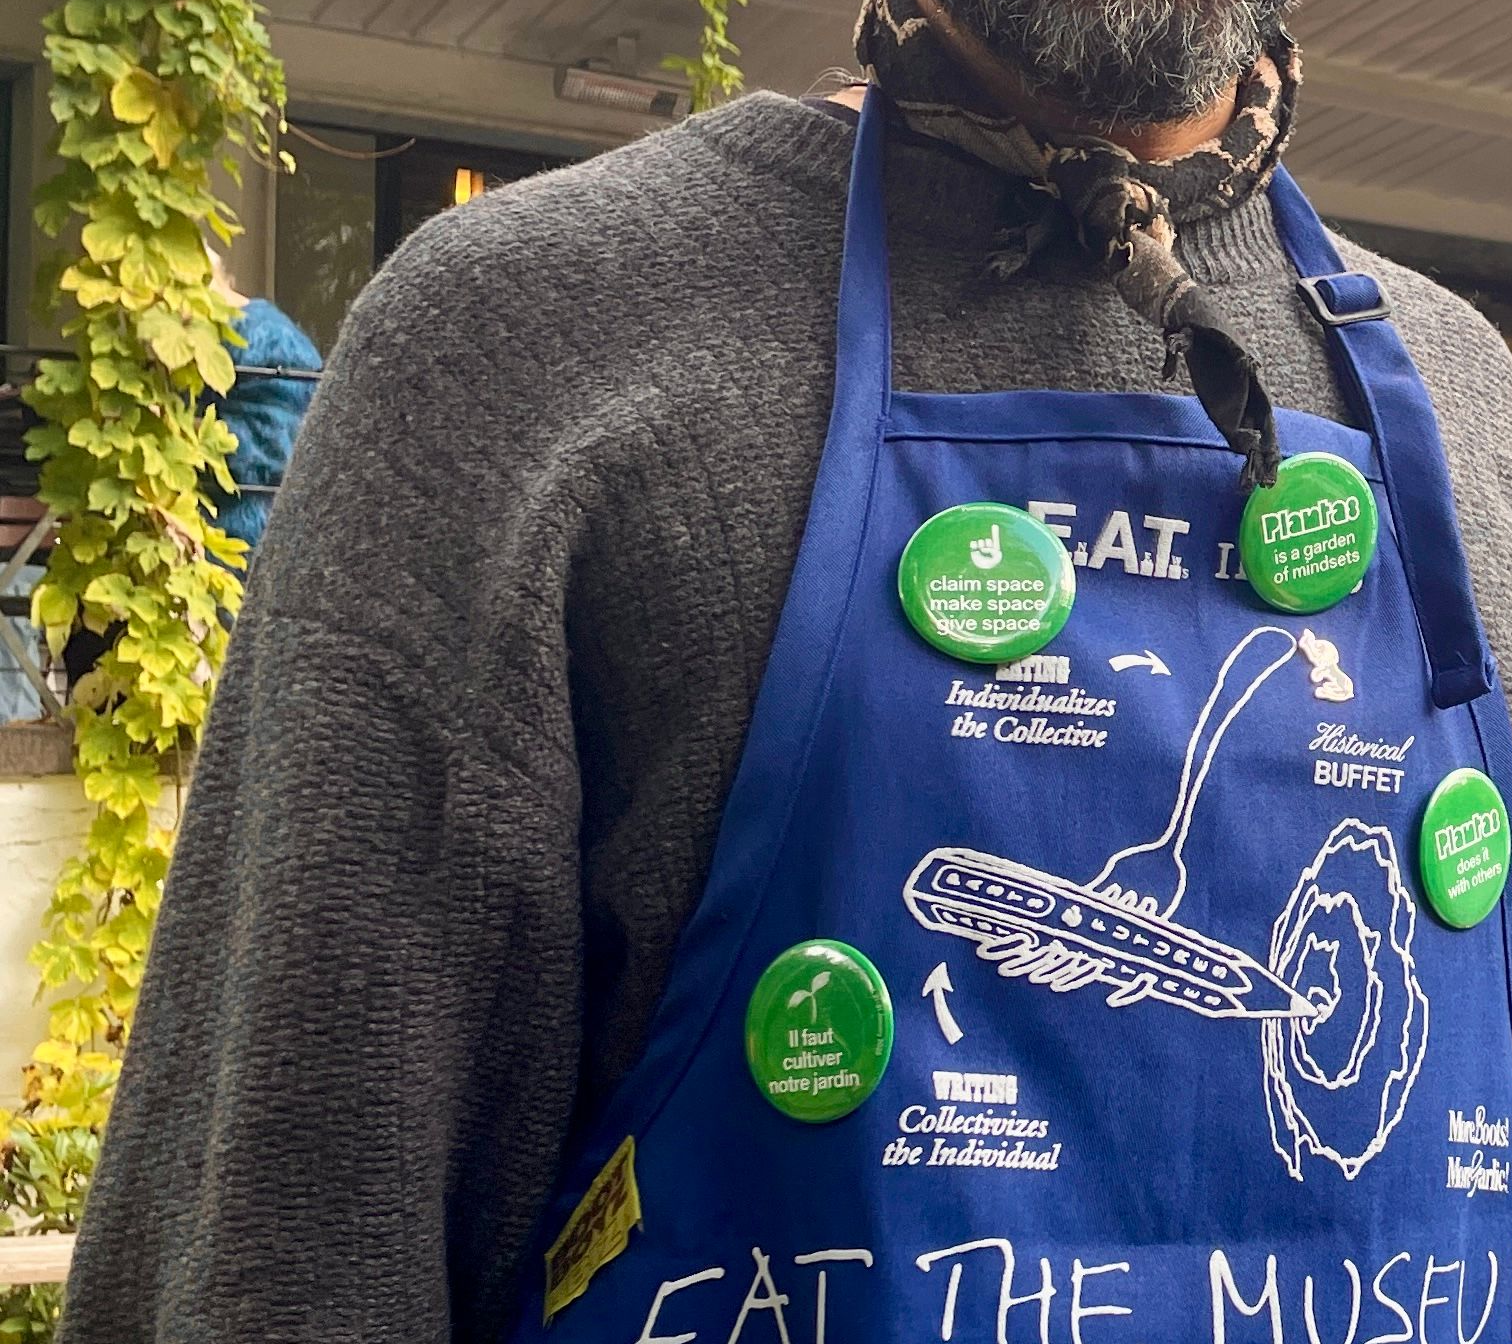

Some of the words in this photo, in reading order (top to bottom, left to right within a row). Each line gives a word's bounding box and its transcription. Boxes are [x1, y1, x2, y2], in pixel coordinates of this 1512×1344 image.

[1261, 496, 1360, 544] Plantas
[1274, 549, 1287, 565] is
[1290, 549, 1300, 561] a
[1303, 532, 1356, 563] garden
[1273, 567, 1289, 584] of
[1292, 550, 1361, 579] mindsets
[930, 575, 982, 592] claim
[986, 578, 1044, 595] space
[930, 595, 983, 612] make
[987, 599, 1047, 615] space
[937, 617, 977, 635] give
[982, 618, 1041, 634] space
[945, 680, 1117, 718] Individualizes
[951, 711, 988, 739] the
[993, 716, 1108, 748] Collective
[1308, 722, 1415, 762] Historical
[1313, 760, 1405, 793] BUFFET
[1456, 856, 1481, 875] does
[1482, 846, 1490, 862] it
[1447, 879, 1470, 899] with
[1472, 863, 1503, 887] others
[1090, 918, 1228, 981] FUTURES
[788, 1030, 799, 1048] Il
[801, 1028, 834, 1047] faut
[783, 1050, 843, 1071] cultiver
[768, 1076, 810, 1094] notre
[813, 1069, 860, 1095] jardin
[898, 1105, 1049, 1139] Collectivizes
[882, 1137, 924, 1166] the
[926, 1138, 1063, 1171] Individual
